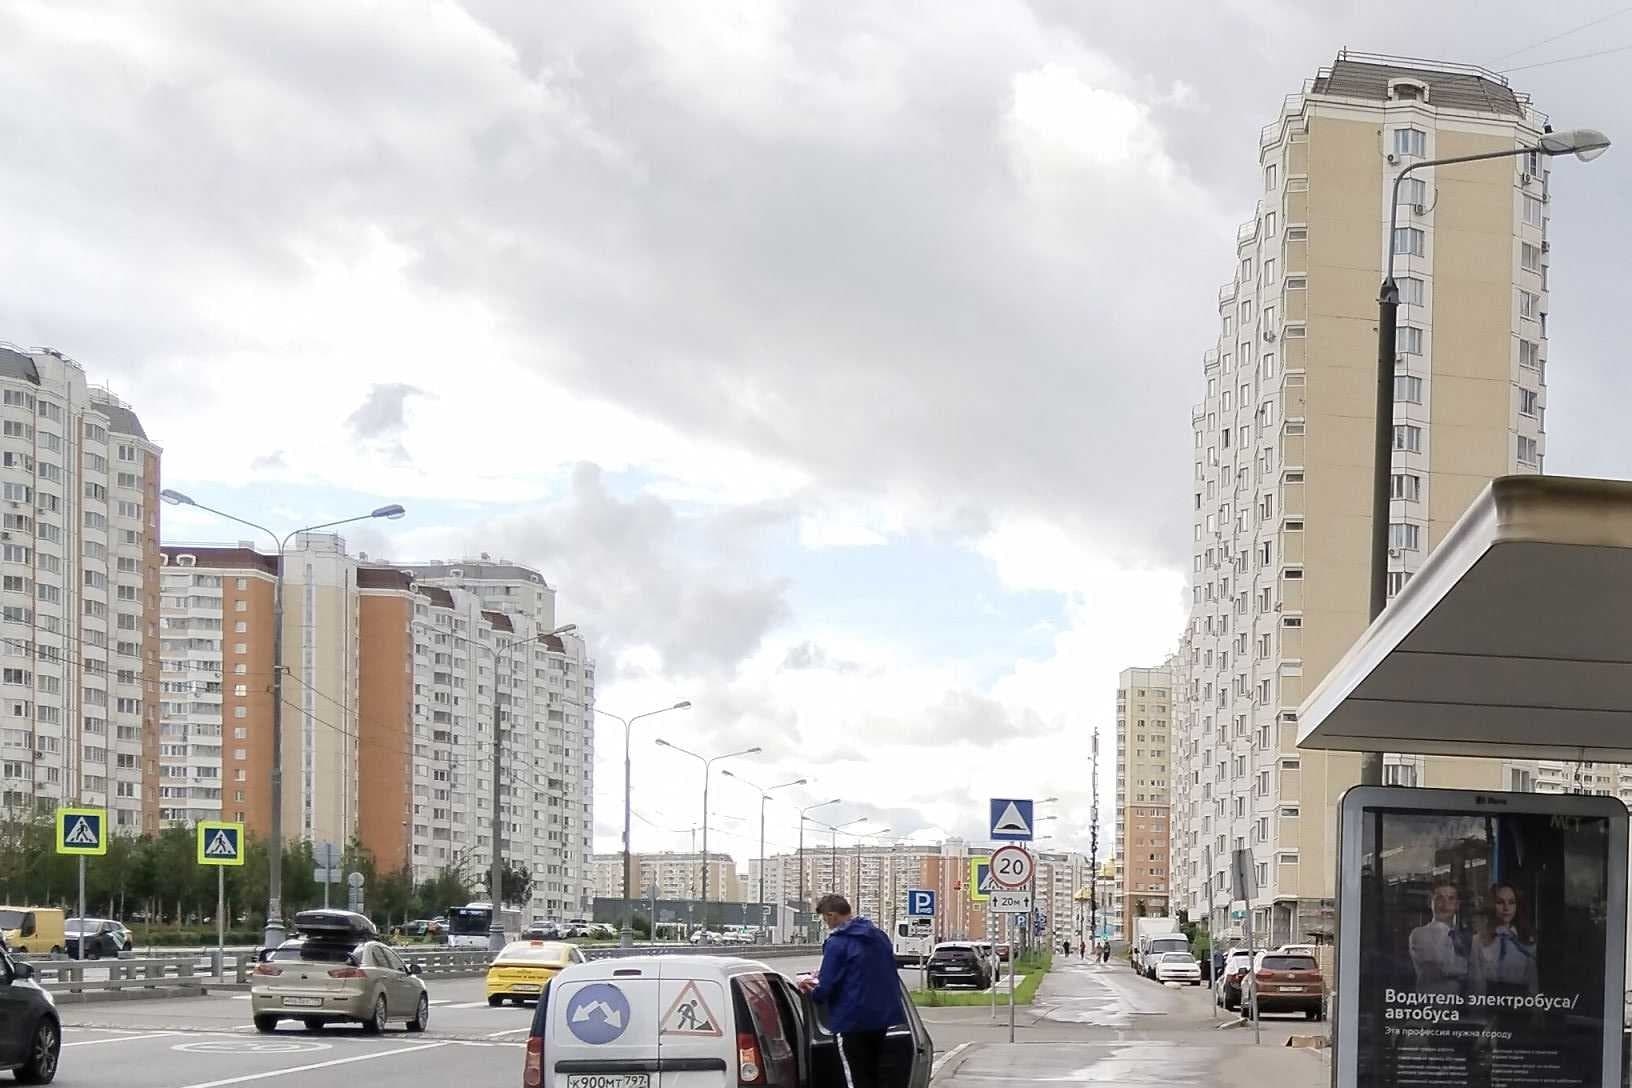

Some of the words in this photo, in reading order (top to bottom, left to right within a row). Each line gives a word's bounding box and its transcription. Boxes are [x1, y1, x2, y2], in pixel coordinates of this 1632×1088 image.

[1000, 858, 1023, 875] 20
[1384, 988, 1464, 1005] Водитель
[1468, 993, 1580, 1011] электробуса/
[1384, 1006, 1460, 1024] автобуса
[1402, 1028, 1450, 1038] профессия
[1481, 1030, 1512, 1040] городу
